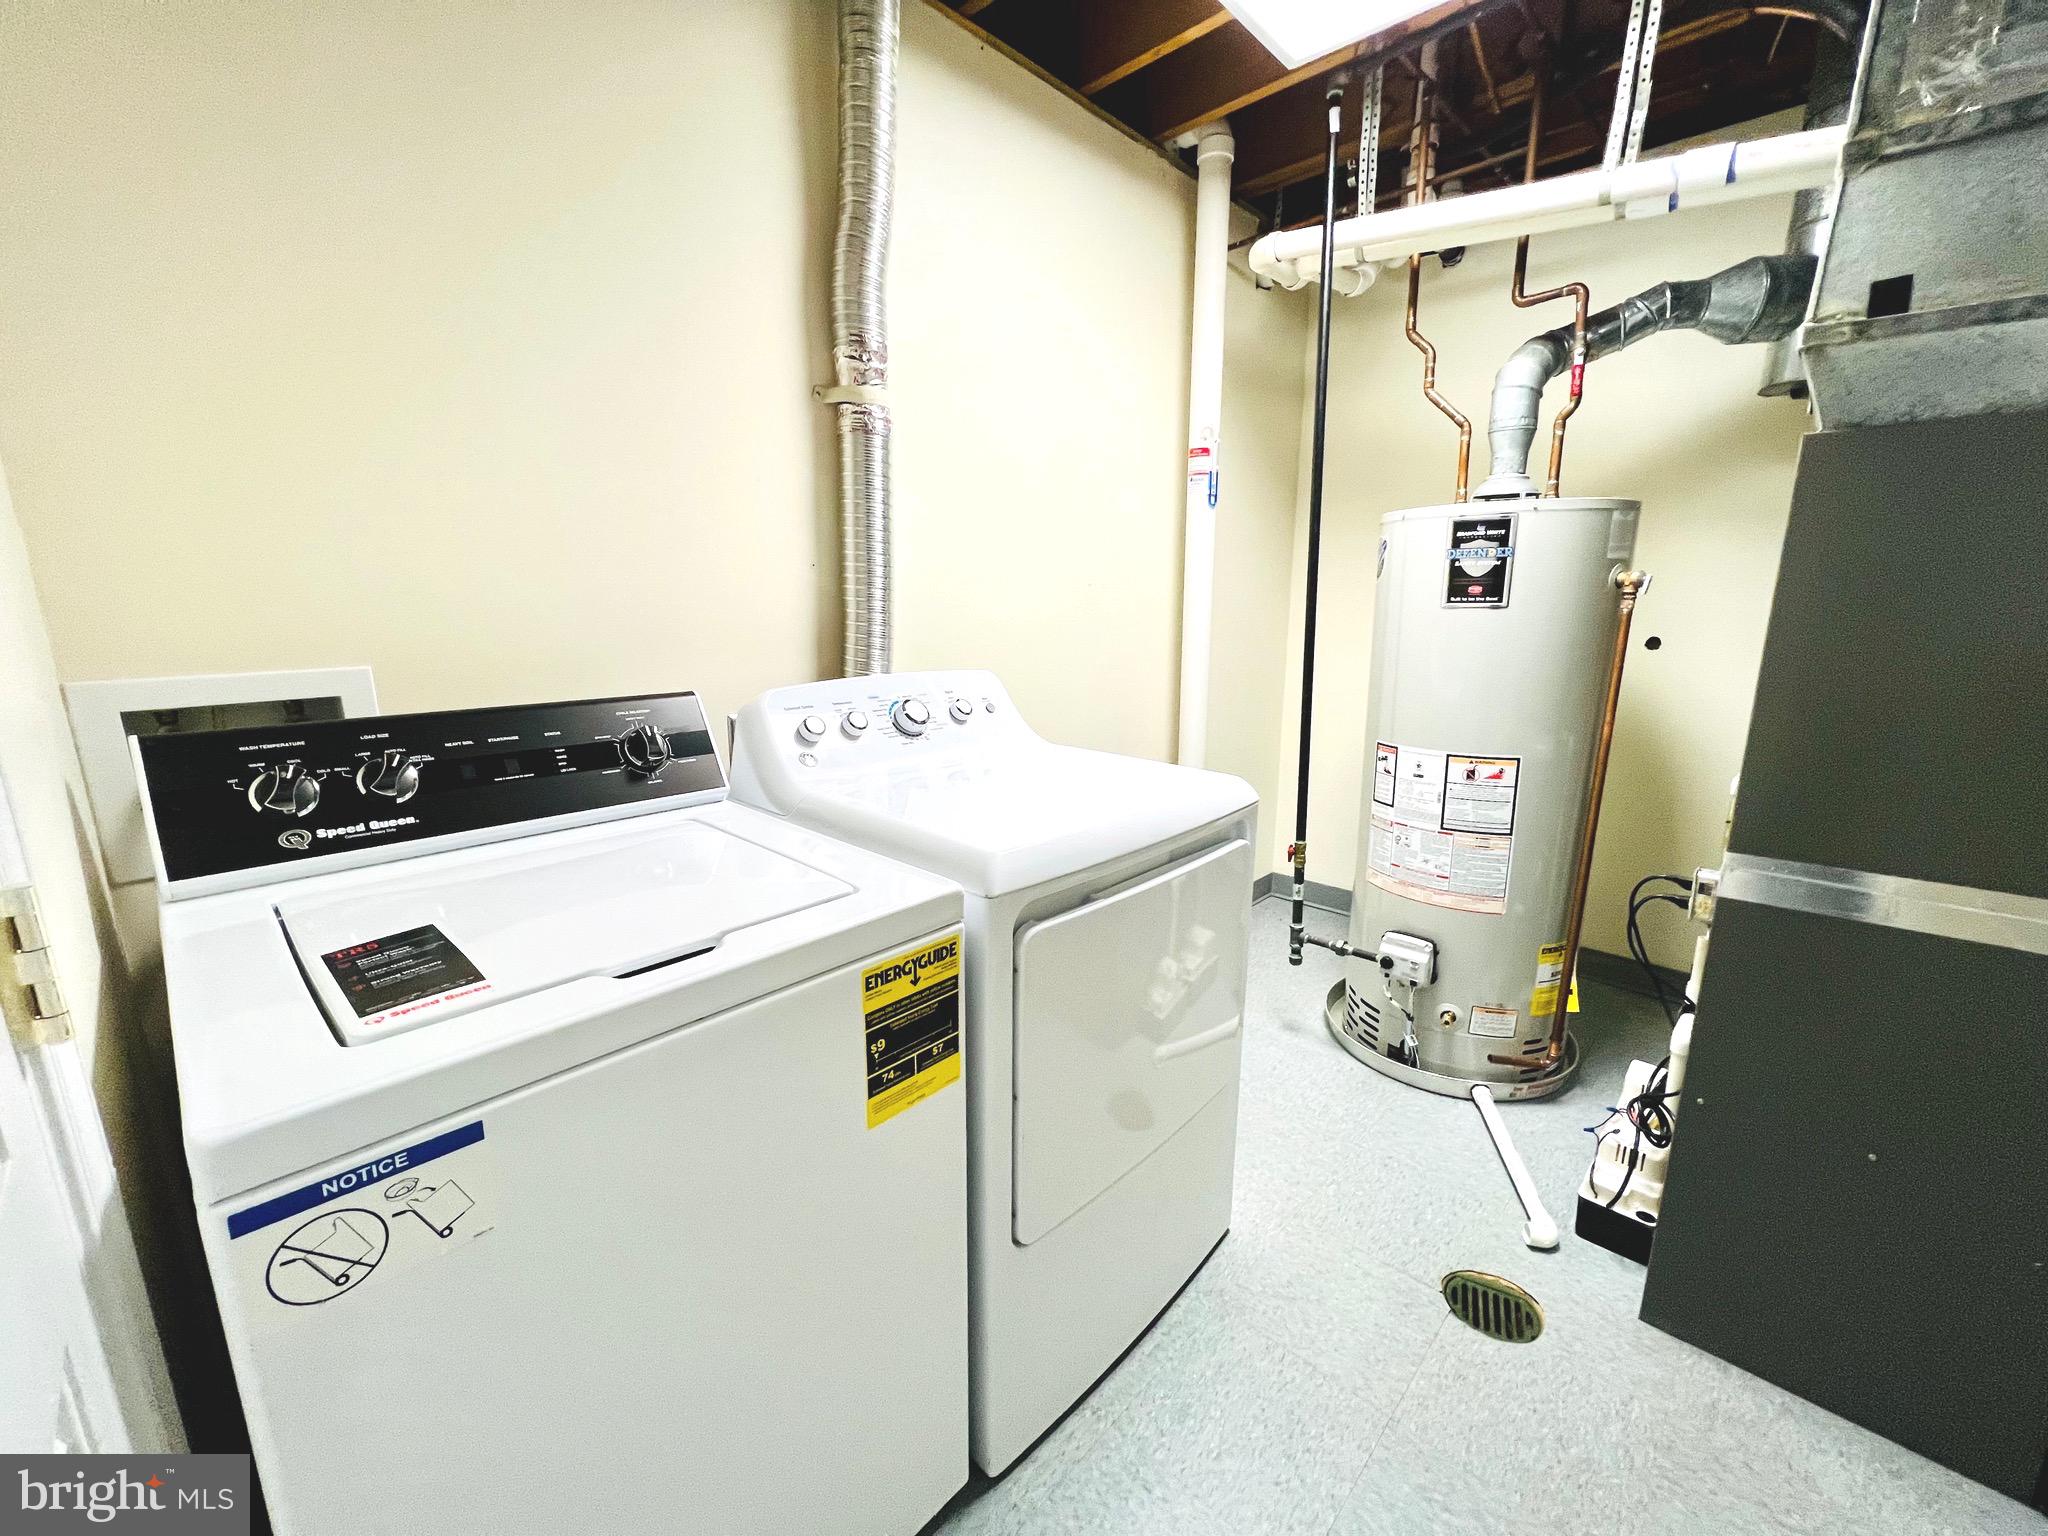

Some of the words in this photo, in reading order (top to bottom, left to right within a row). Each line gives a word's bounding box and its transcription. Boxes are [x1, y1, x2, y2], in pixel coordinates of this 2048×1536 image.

[1448, 547, 1513, 559] DEFENDER
[259, 740, 306, 750] TEMPERATURE
[315, 821, 366, 840] Speed
[864, 940, 958, 993] ENERGYGUIDE
[389, 999, 441, 1017] Speed
[444, 984, 492, 1001] Queen
[870, 1039, 886, 1054] $9
[932, 1042, 944, 1055] $7
[881, 1070, 895, 1083] 74
[321, 1151, 409, 1198] NOTICE
